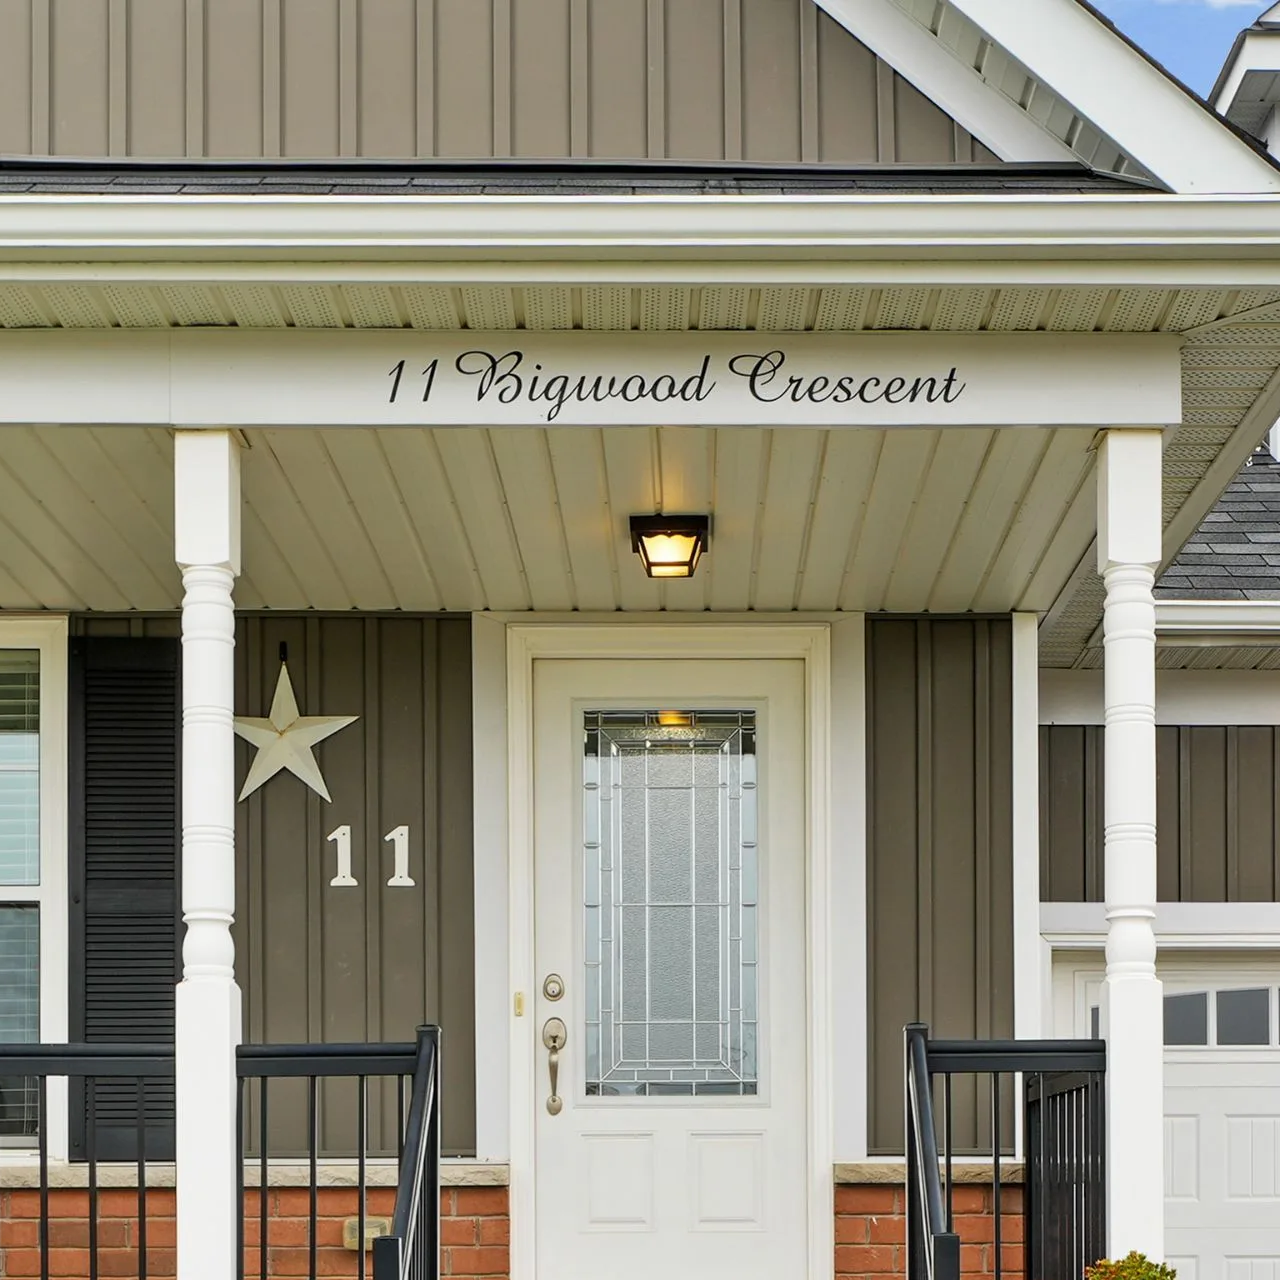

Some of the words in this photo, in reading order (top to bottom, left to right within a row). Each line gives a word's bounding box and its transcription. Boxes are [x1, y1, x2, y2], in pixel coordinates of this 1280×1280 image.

[386, 358, 440, 404] 11
[455, 350, 717, 422] Bigwood
[728, 350, 967, 404] Crescent
[326, 824, 416, 887] 11
